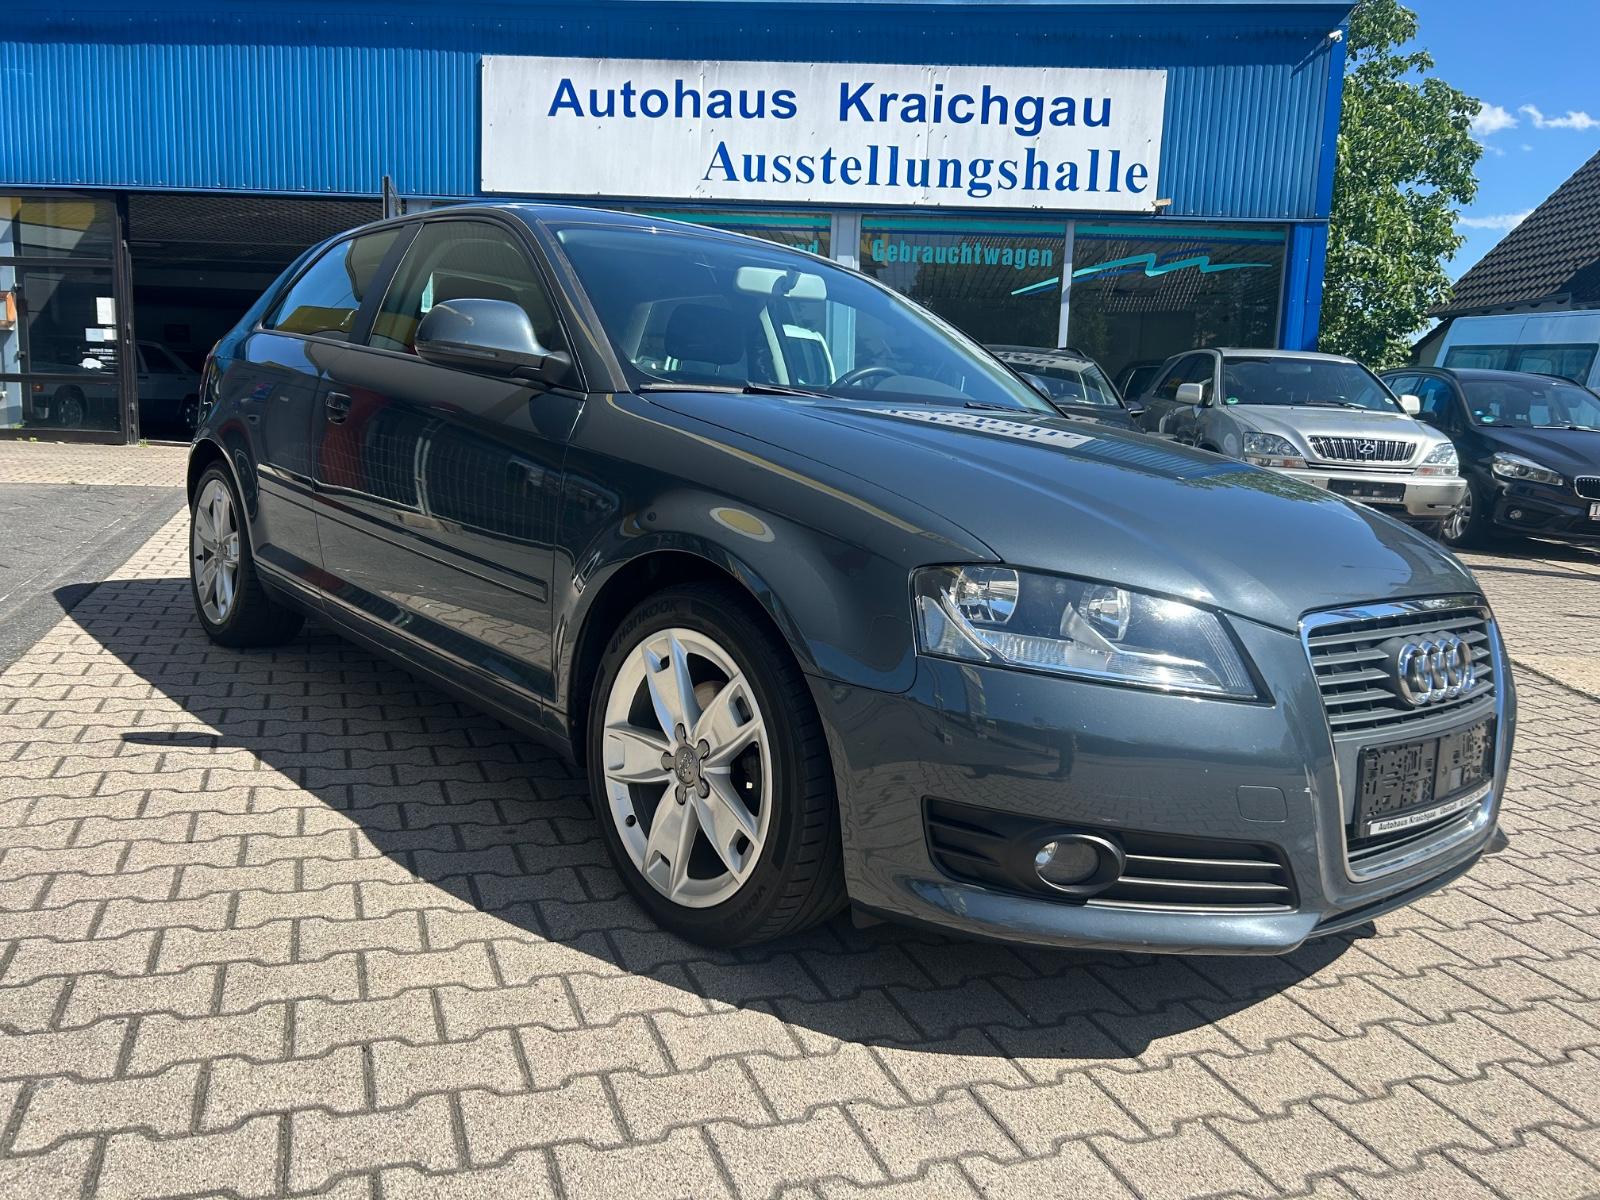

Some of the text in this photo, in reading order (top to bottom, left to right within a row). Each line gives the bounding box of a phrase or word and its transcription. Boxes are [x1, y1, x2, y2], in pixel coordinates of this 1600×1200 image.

[547, 78, 1112, 138] Autohaus Kraichgau
[703, 140, 1149, 199] Ausstellungshalle
[871, 238, 1054, 270] Gebrauchtwagen
[1378, 819, 1408, 831] Autohaus
